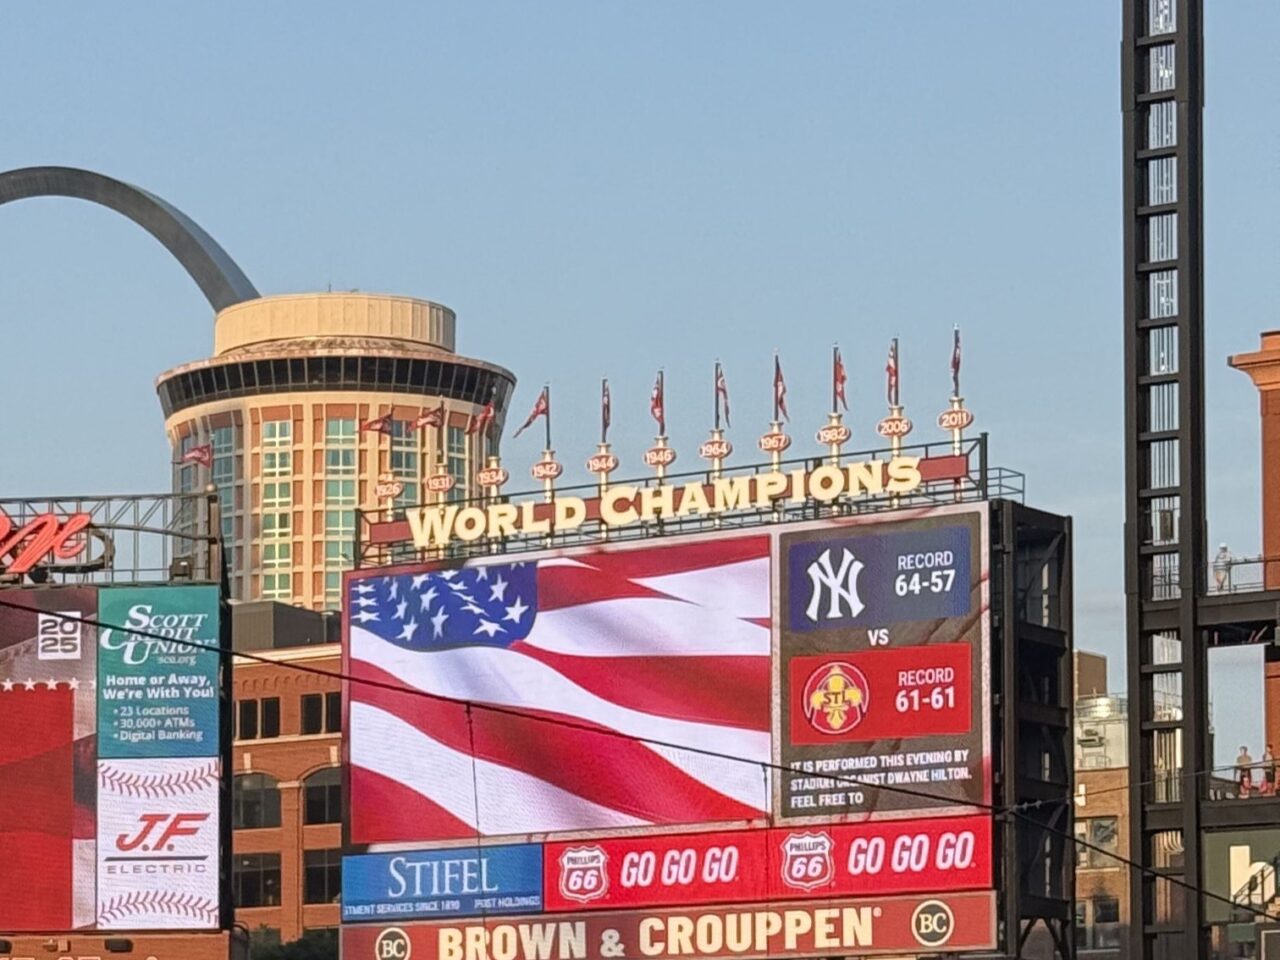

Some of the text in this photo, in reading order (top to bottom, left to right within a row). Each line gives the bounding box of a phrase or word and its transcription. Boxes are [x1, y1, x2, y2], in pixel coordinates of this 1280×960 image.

[941, 412, 967, 426] 2011
[880, 420, 908, 434] 2006
[819, 428, 846, 442] 1982
[701, 441, 727, 456] 1964
[761, 436, 786, 450] 1967
[588, 457, 614, 472] 1944
[646, 450, 671, 465] 1946
[479, 470, 503, 484] 1934
[532, 464, 558, 478] 1942
[376, 482, 399, 497] 1926
[427, 478, 450, 491] 1931
[406, 457, 922, 547] WORLD CHAMPIONS
[898, 551, 954, 571] RECORD
[895, 569, 956, 597] 64-57
[106, 673, 210, 687] Home or Away,
[898, 667, 954, 686] RECORD
[103, 687, 214, 700] We're With You!
[896, 686, 955, 712] 61-61
[120, 706, 190, 716] 23 Locations
[164, 717, 195, 728] ATMs
[120, 730, 203, 742] Digital Banking
[803, 760, 814, 772] IS
[815, 756, 878, 772] PERFORMED
[880, 754, 904, 768] THIS
[906, 751, 952, 765] EVENING
[954, 749, 970, 762] BY
[887, 769, 929, 784] DWAYNE
[931, 766, 973, 781] HILTON.
[791, 791, 865, 809] FEEL FREE TO
[789, 840, 826, 852] PHILLIPS
[791, 831, 975, 878] 66 GO GO GO
[107, 864, 207, 874] ELECTRIC
[568, 846, 739, 890] 66 GO GO GO
[388, 857, 498, 897] STIFEL
[381, 939, 405, 958] BC
[599, 928, 625, 958] &
[919, 913, 947, 934] BC
